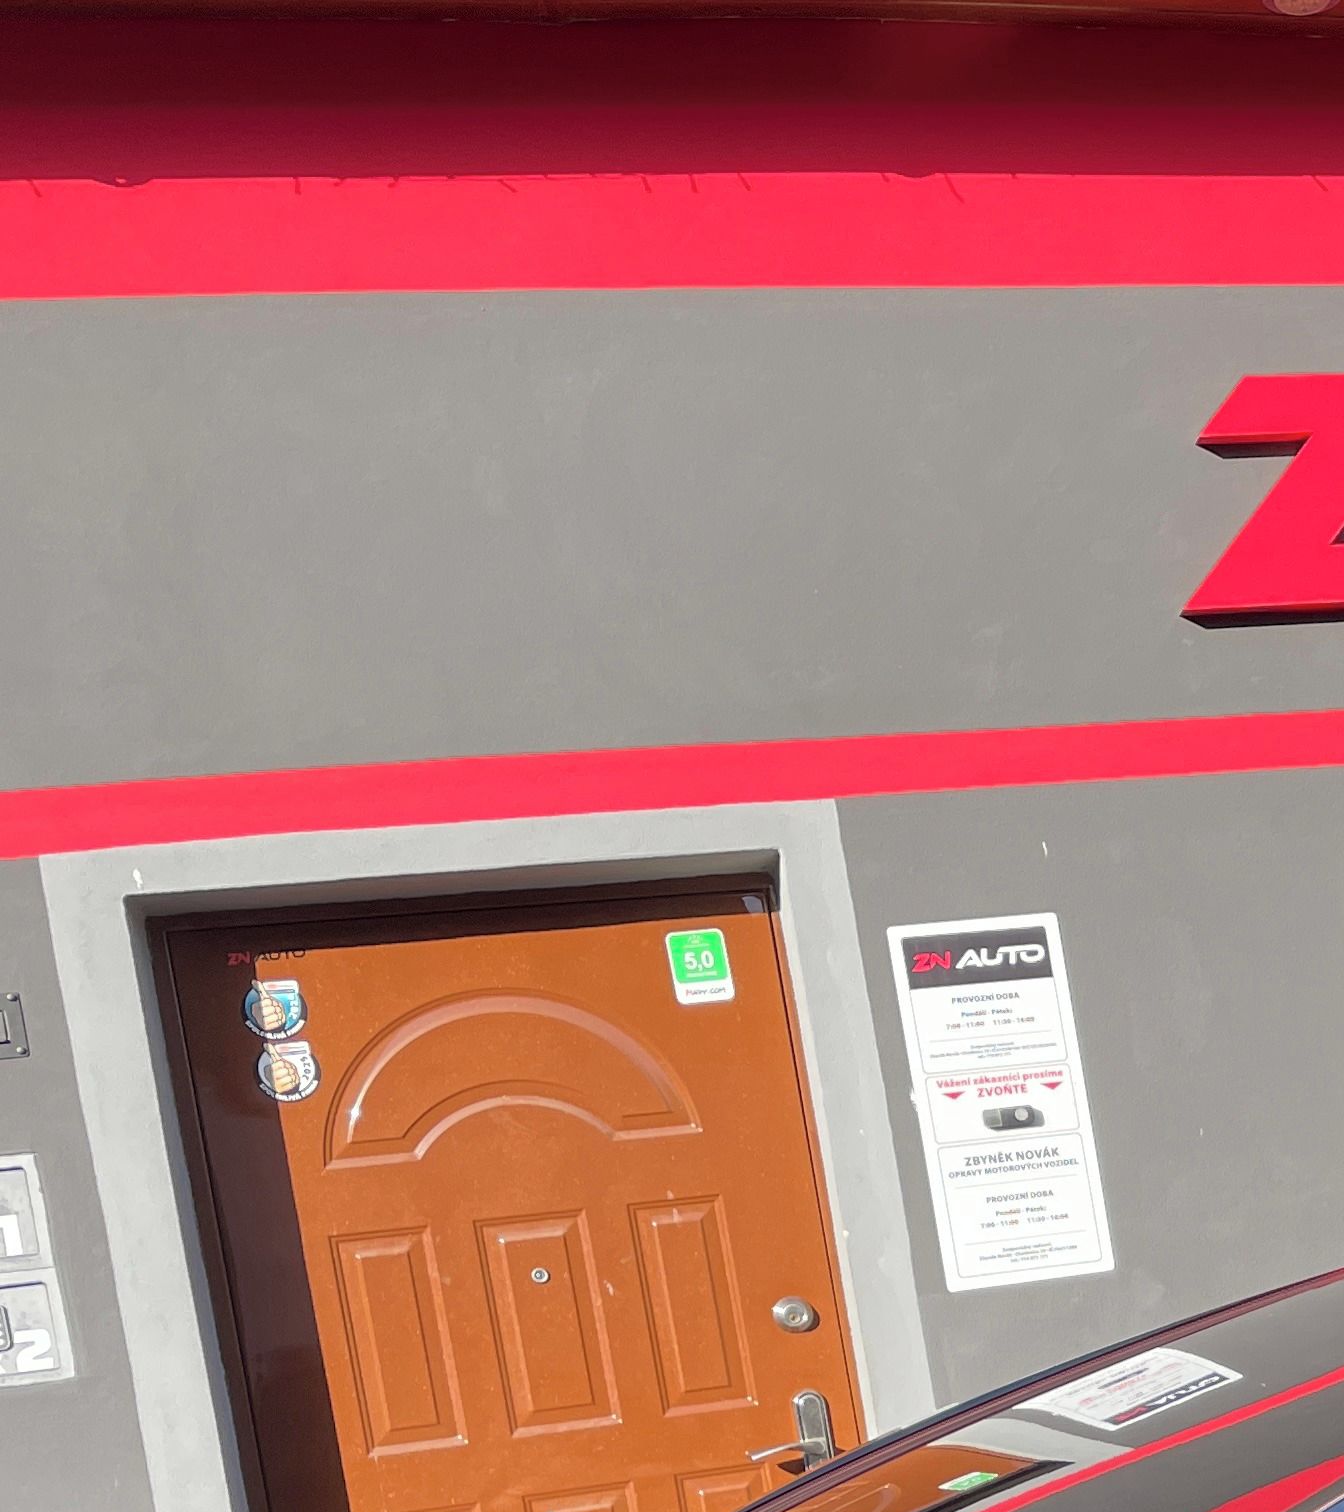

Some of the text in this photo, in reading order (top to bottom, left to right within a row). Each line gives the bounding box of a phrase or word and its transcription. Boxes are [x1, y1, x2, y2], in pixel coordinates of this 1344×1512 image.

[684, 950, 715, 972] 5,0
[911, 943, 1045, 973] ZN AUTO
[951, 991, 1020, 1005] PROVOZNÍ DOBA
[936, 1069, 1064, 1089] Vážení zákazníci prosíme
[977, 1083, 1029, 1098] ZVOŇTE
[1015, 1146, 1060, 1161] NOVÁK
[948, 1158, 1079, 1179] OPRAVY MOTOROVÝCH VOZIDEL
[986, 1189, 1054, 1204] PROVOZNÍ DOBA
